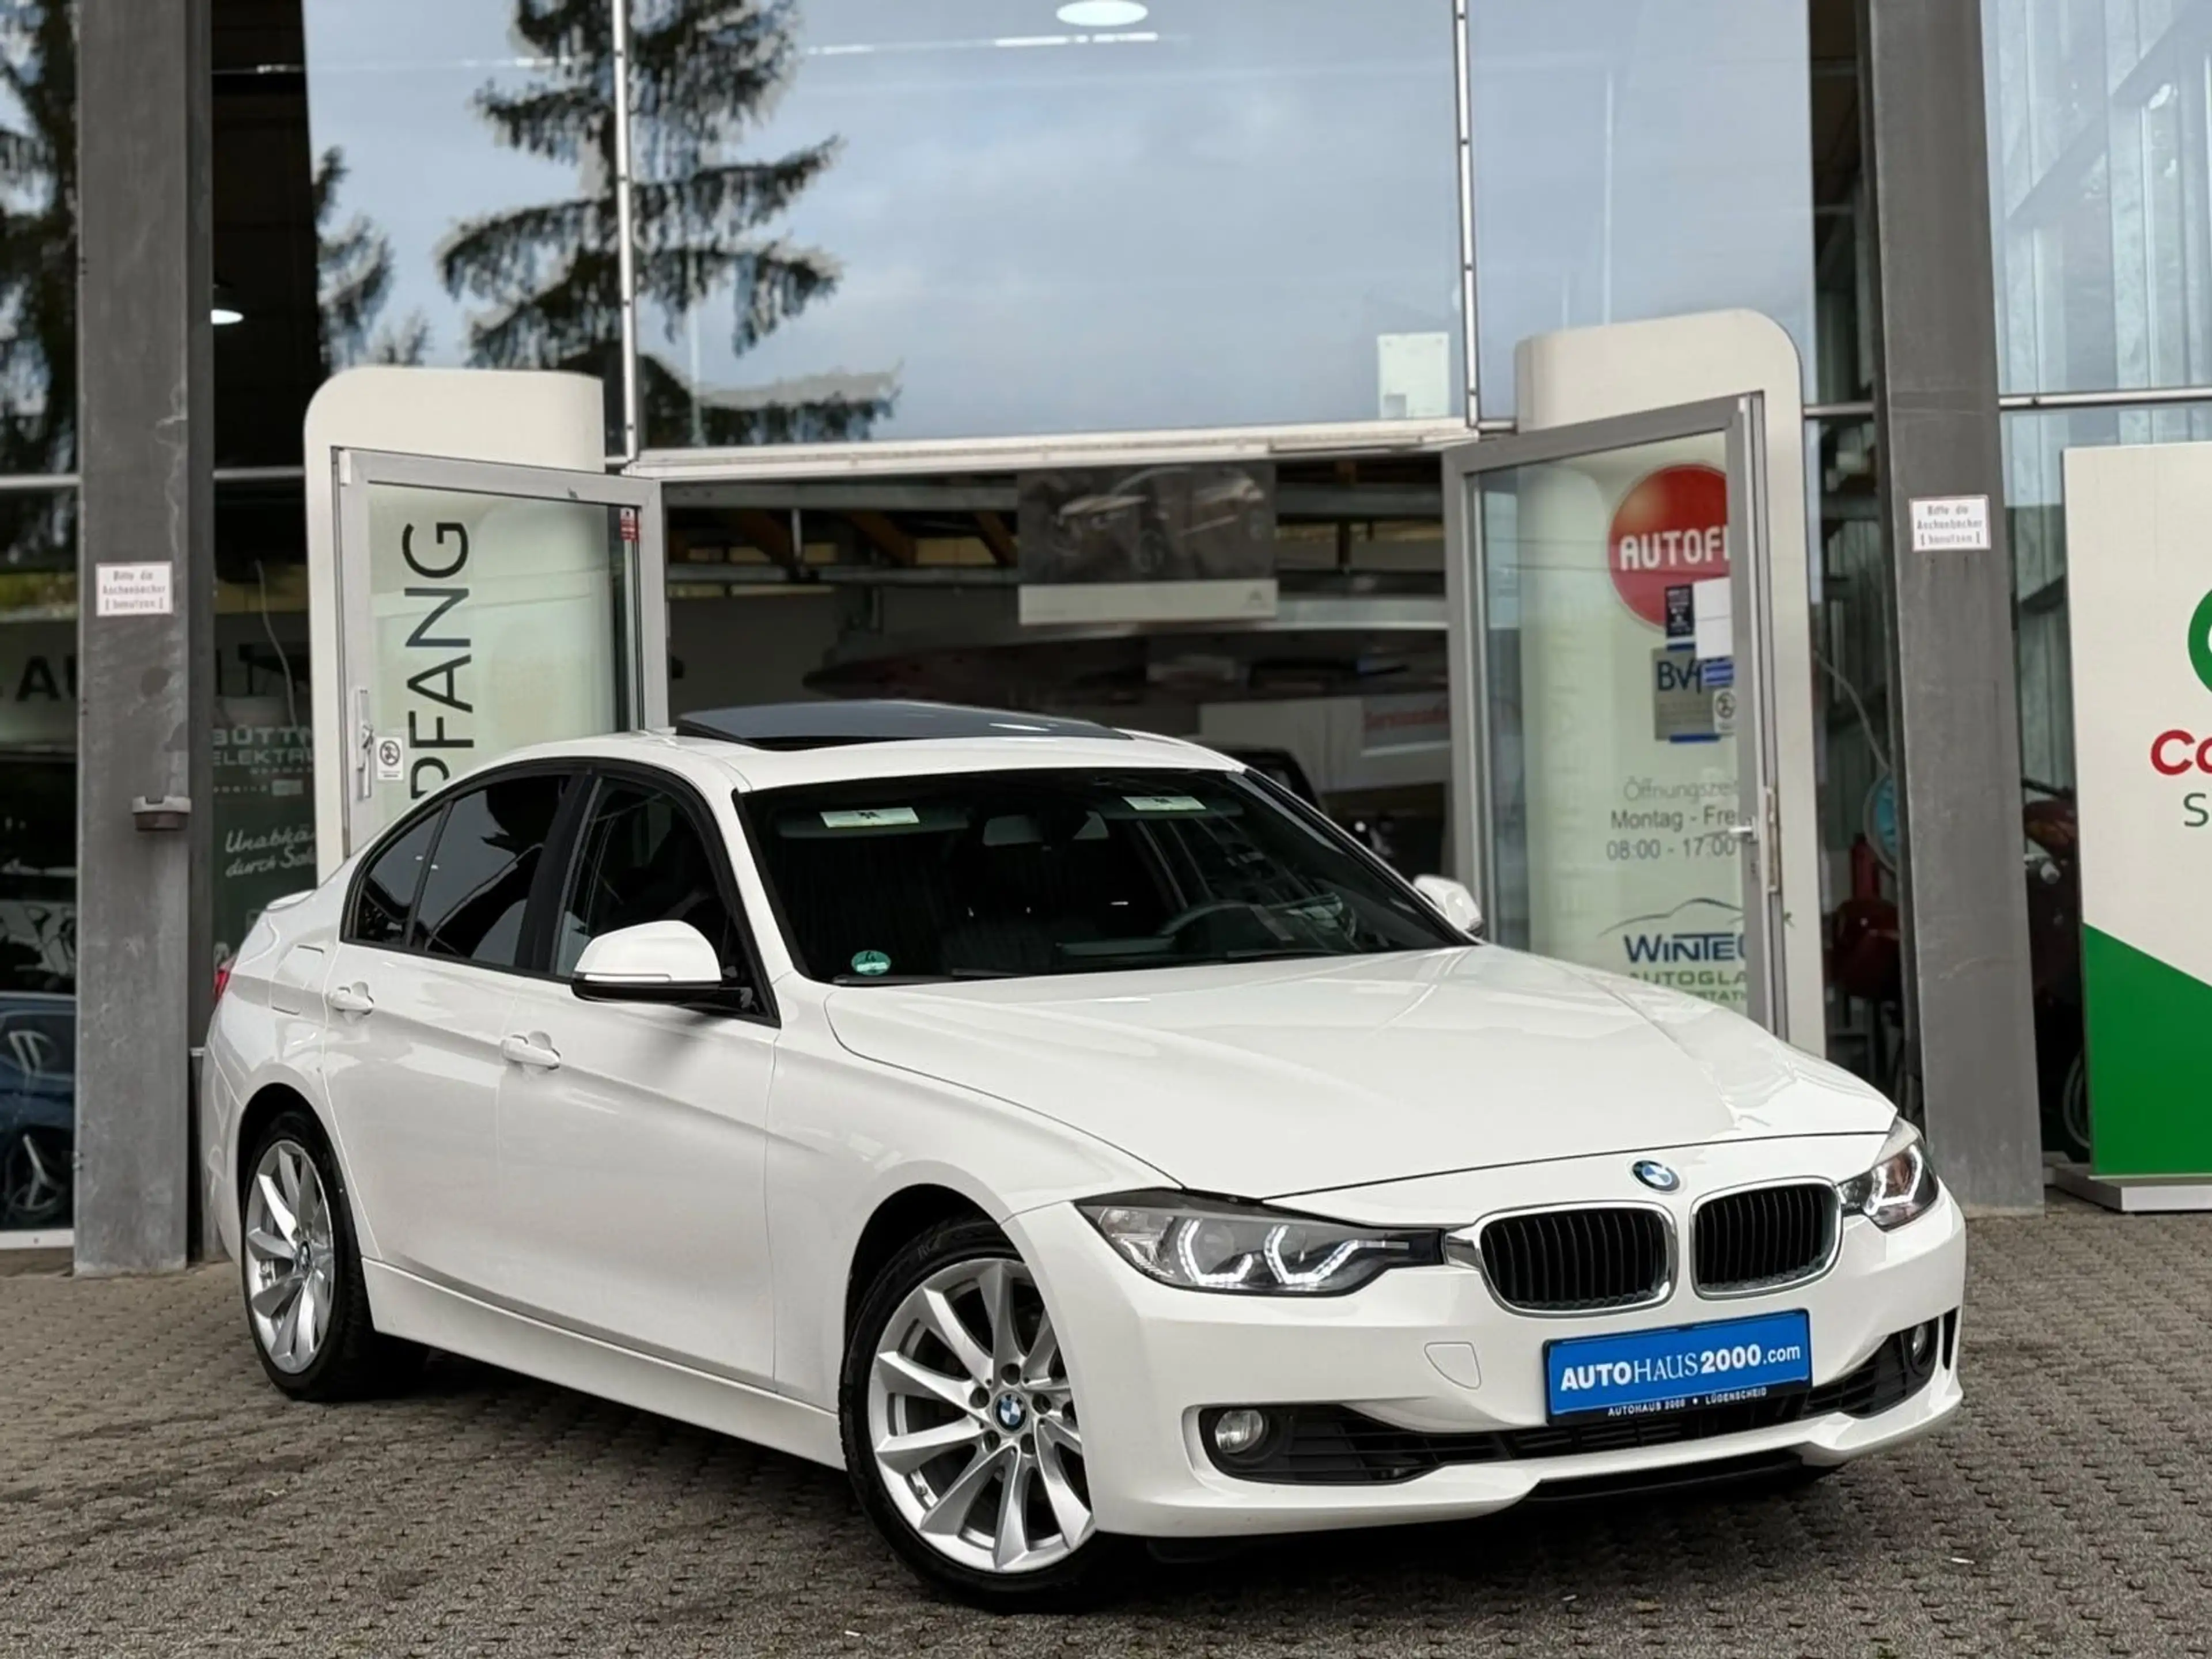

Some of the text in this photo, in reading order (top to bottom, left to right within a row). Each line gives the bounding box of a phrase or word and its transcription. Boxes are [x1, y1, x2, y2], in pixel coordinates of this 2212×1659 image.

[1611, 809, 1684, 833] Montag
[1606, 838, 1661, 861] 08:00
[1683, 835, 1737, 857] 17:00
[1560, 1343, 1801, 1391] AUTOHAUS2000.com
[1608, 1386, 1768, 1417] AUTOHAUS 2000 LÜDENSCHEID
